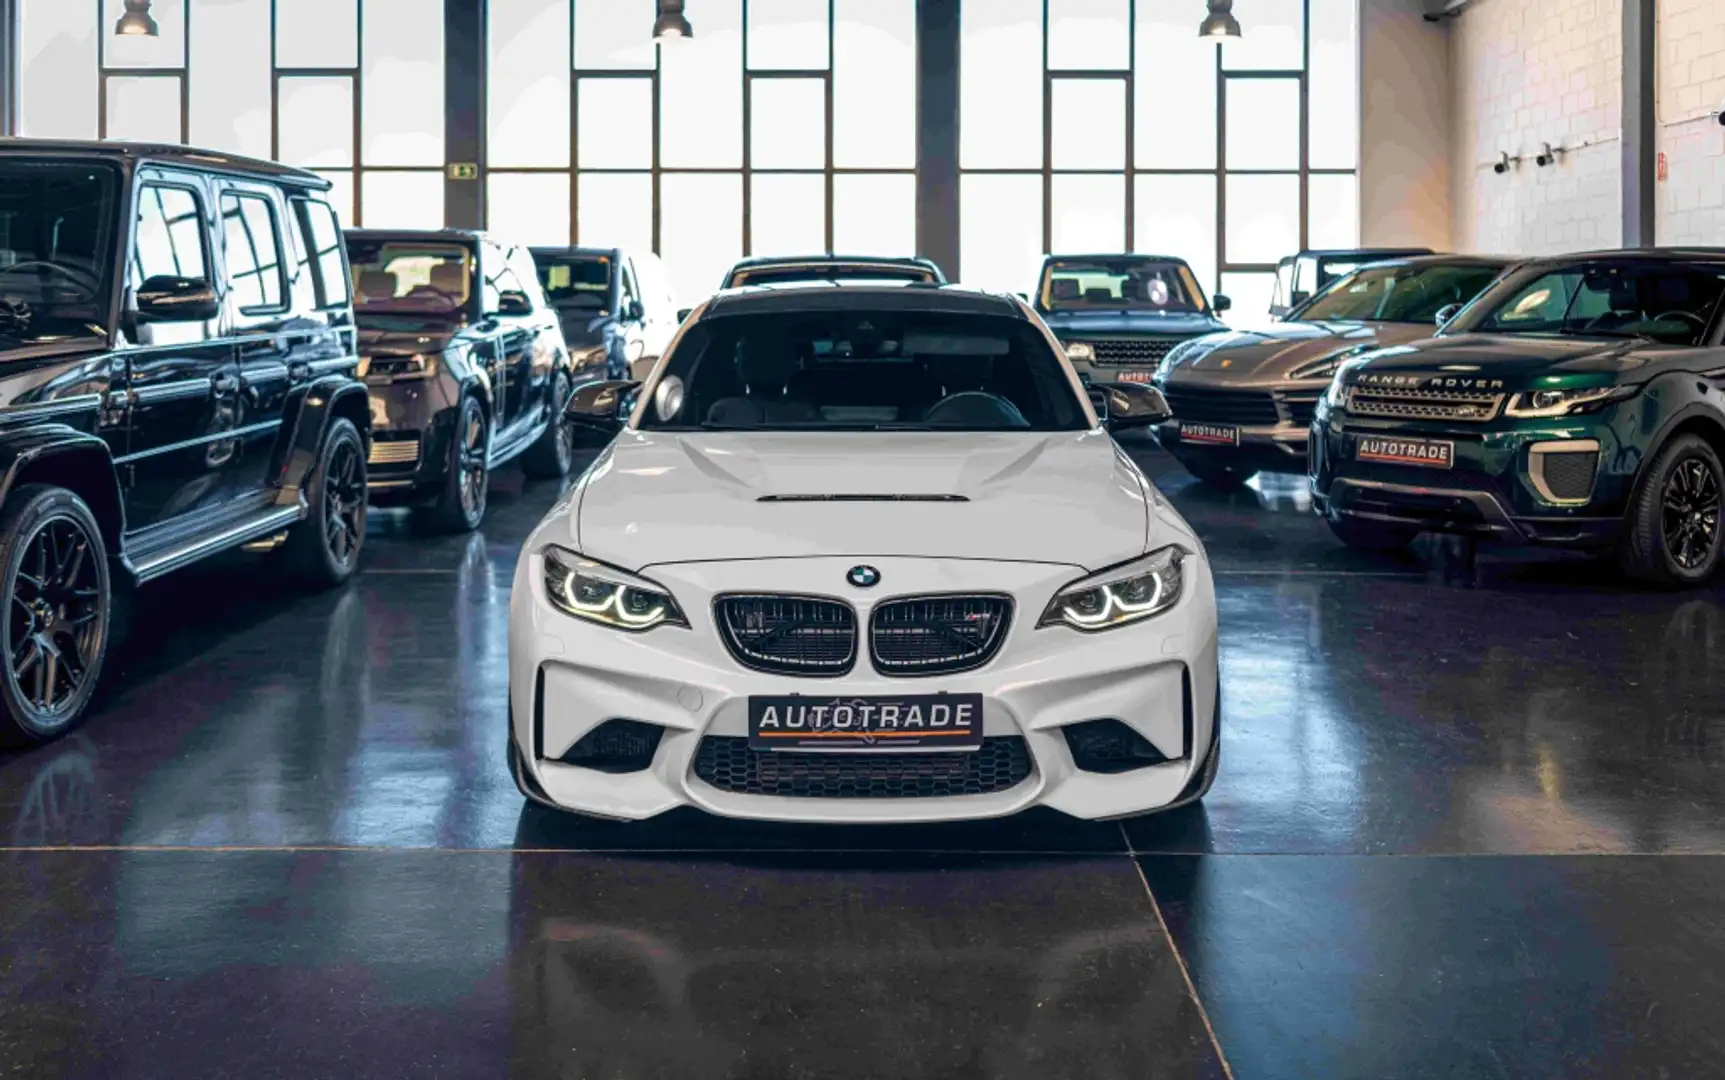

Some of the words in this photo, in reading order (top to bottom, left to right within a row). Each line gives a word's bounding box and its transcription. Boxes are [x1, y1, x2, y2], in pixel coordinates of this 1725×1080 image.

[1119, 371, 1152, 381] AUTOT
[1357, 373, 1420, 385] RANGE
[1431, 377, 1504, 389] ROVER
[1180, 424, 1235, 440] AUTOTRADE
[1359, 439, 1449, 460] AUTOTRADE
[758, 703, 974, 728] AUTOTRADE
